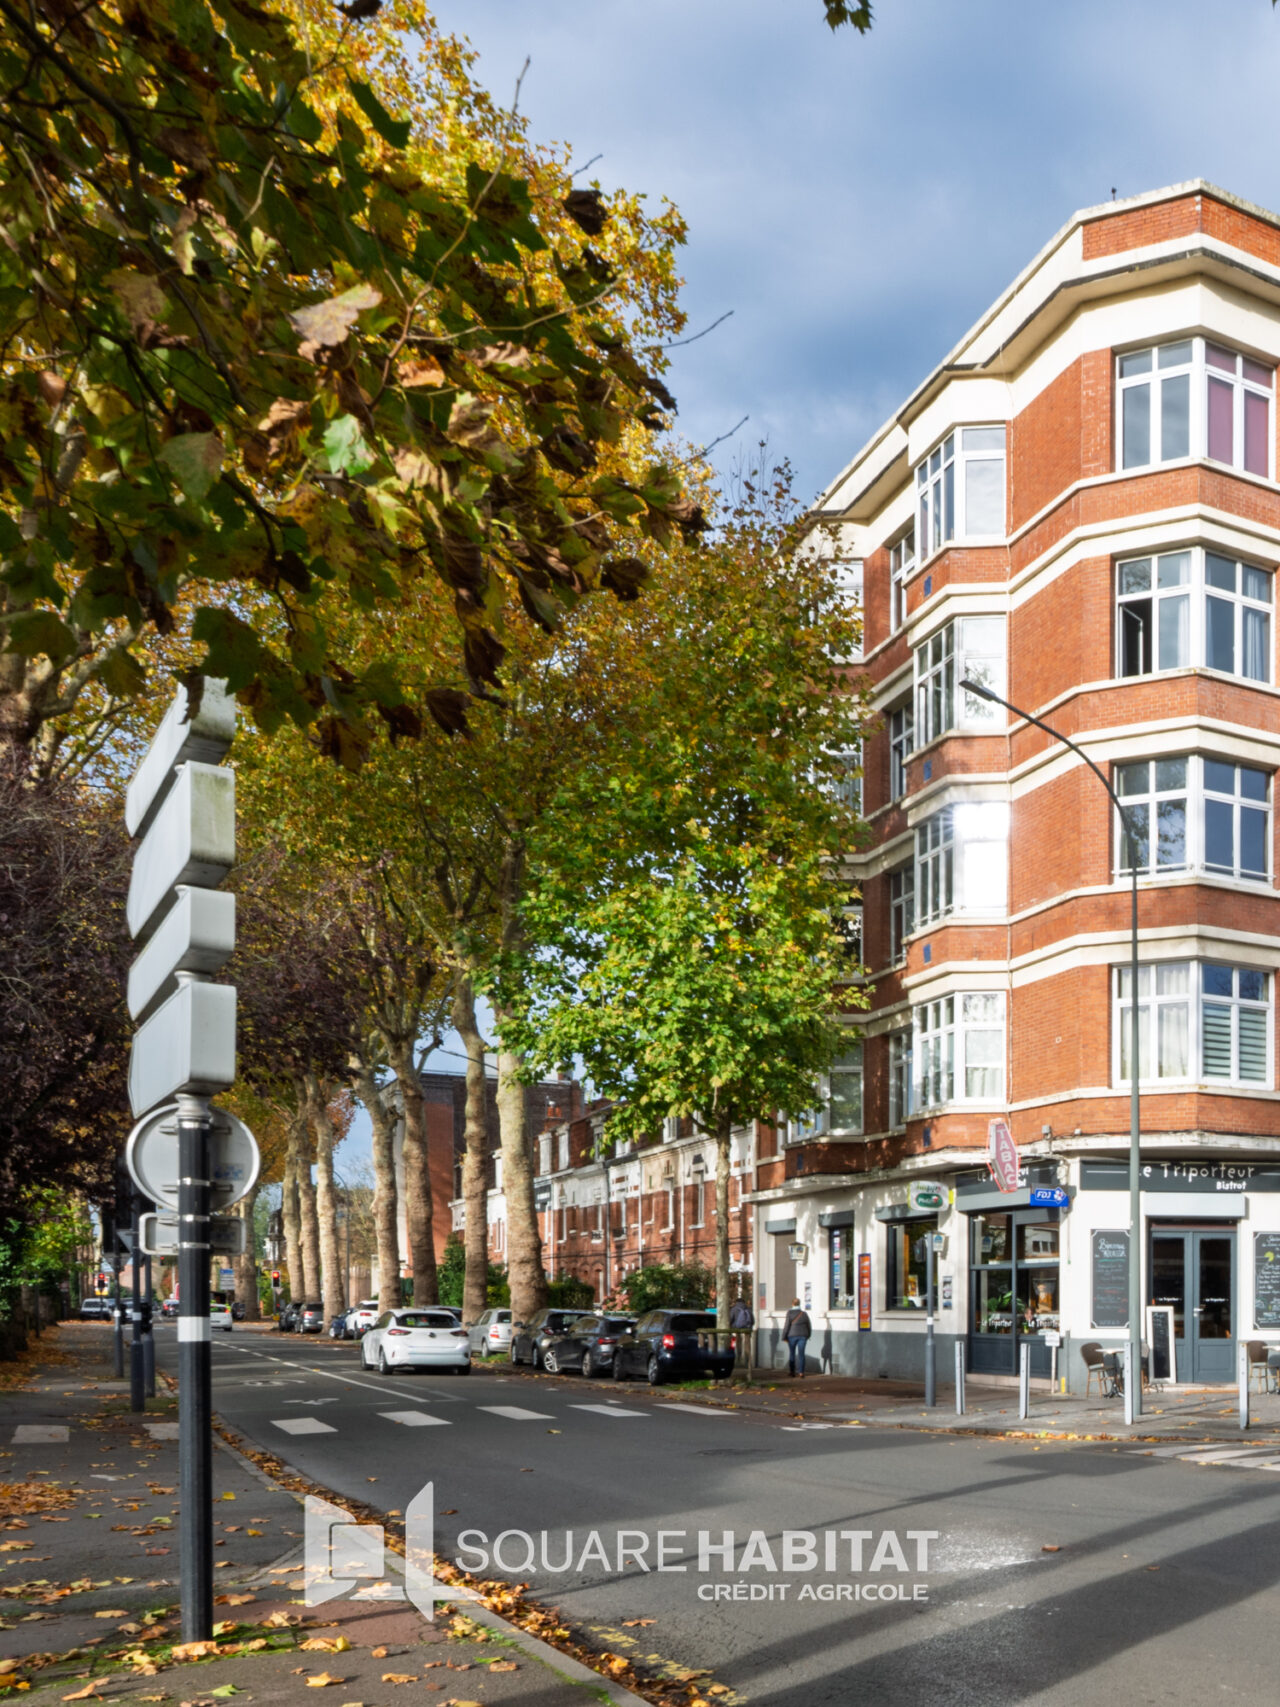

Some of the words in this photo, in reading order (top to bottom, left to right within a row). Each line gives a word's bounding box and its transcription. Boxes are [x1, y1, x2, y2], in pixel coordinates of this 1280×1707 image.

[997, 1129, 1016, 1184] TABAC
[1139, 1165, 1152, 1178] e
[1160, 1163, 1255, 1182] Triporteur
[1216, 1181, 1247, 1190] Bistrot
